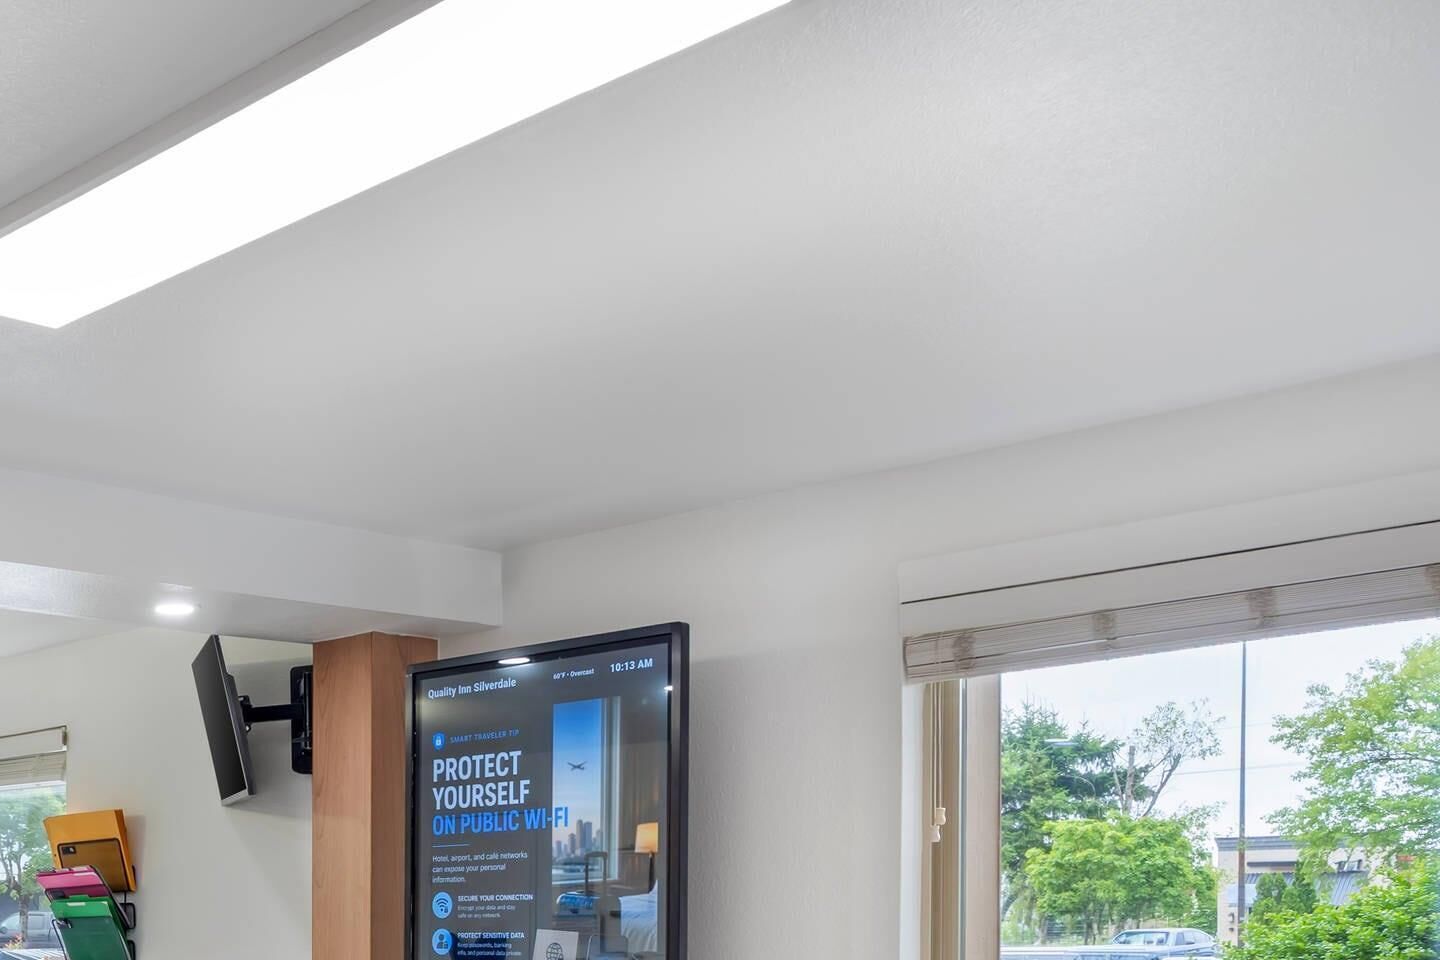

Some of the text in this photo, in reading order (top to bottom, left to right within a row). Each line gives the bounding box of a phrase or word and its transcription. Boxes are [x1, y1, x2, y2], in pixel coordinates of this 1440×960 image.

[570, 667, 595, 678] Overcast
[610, 658, 653, 673] 10:13 AM
[428, 678, 516, 699] Quality Inn Silverdale
[450, 733, 473, 744] SMART
[474, 730, 506, 742] TRAVELER
[433, 750, 522, 782] PROTECT
[432, 780, 530, 810] YOURSELF
[433, 806, 569, 836] ON PUBLIC WI-FI
[432, 854, 449, 862] Hotel,
[450, 854, 472, 862] airport,
[500, 851, 528, 859] networks
[465, 865, 479, 873] your
[480, 863, 506, 872] personal
